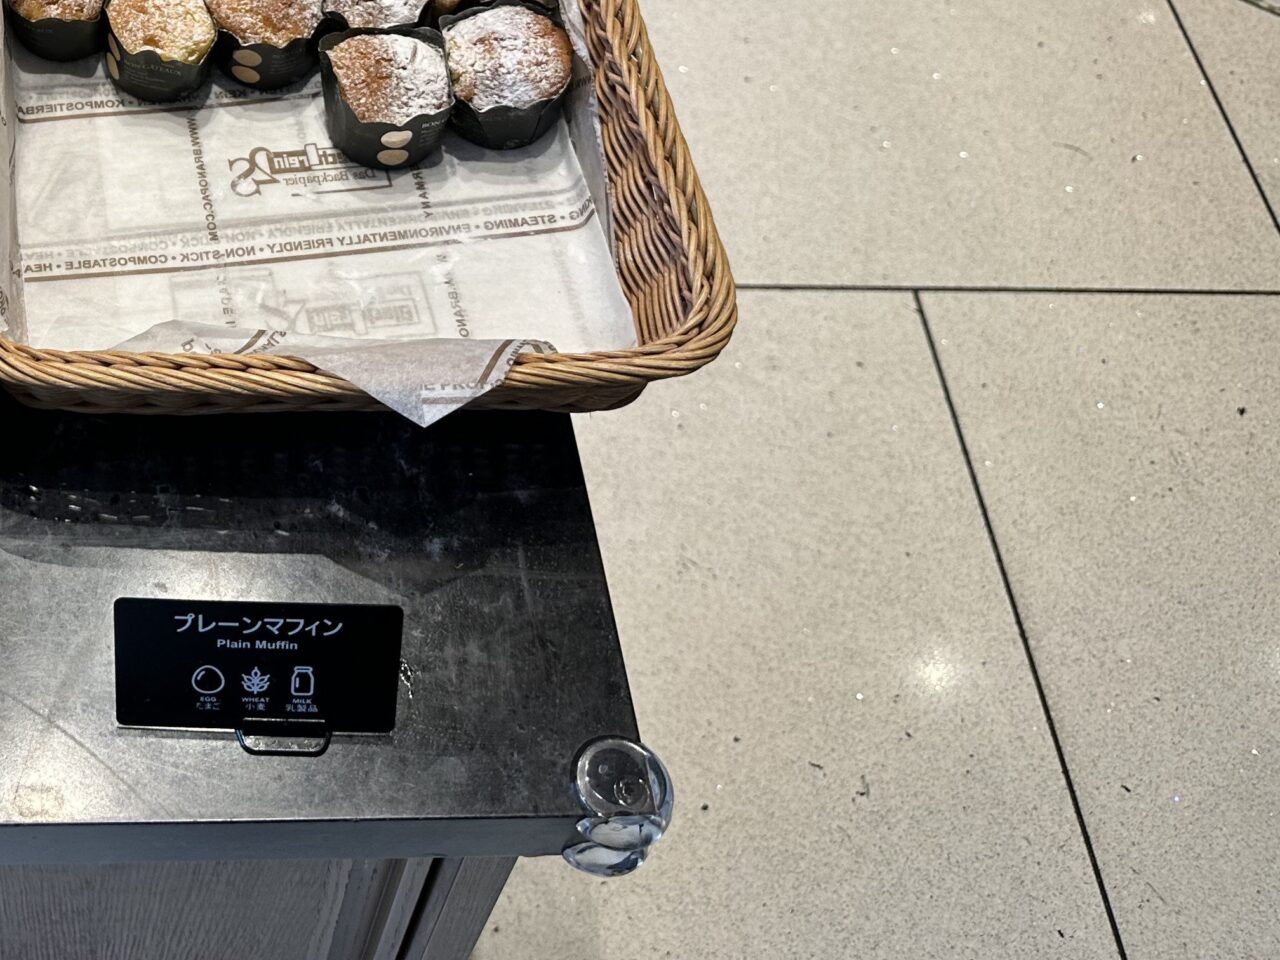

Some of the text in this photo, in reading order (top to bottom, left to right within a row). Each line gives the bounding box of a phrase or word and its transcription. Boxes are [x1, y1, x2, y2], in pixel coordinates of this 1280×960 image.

[174, 613, 343, 637] プレーンマフィン
[216, 638, 299, 651] Plain Muffin
[241, 696, 270, 704] WHEAT
